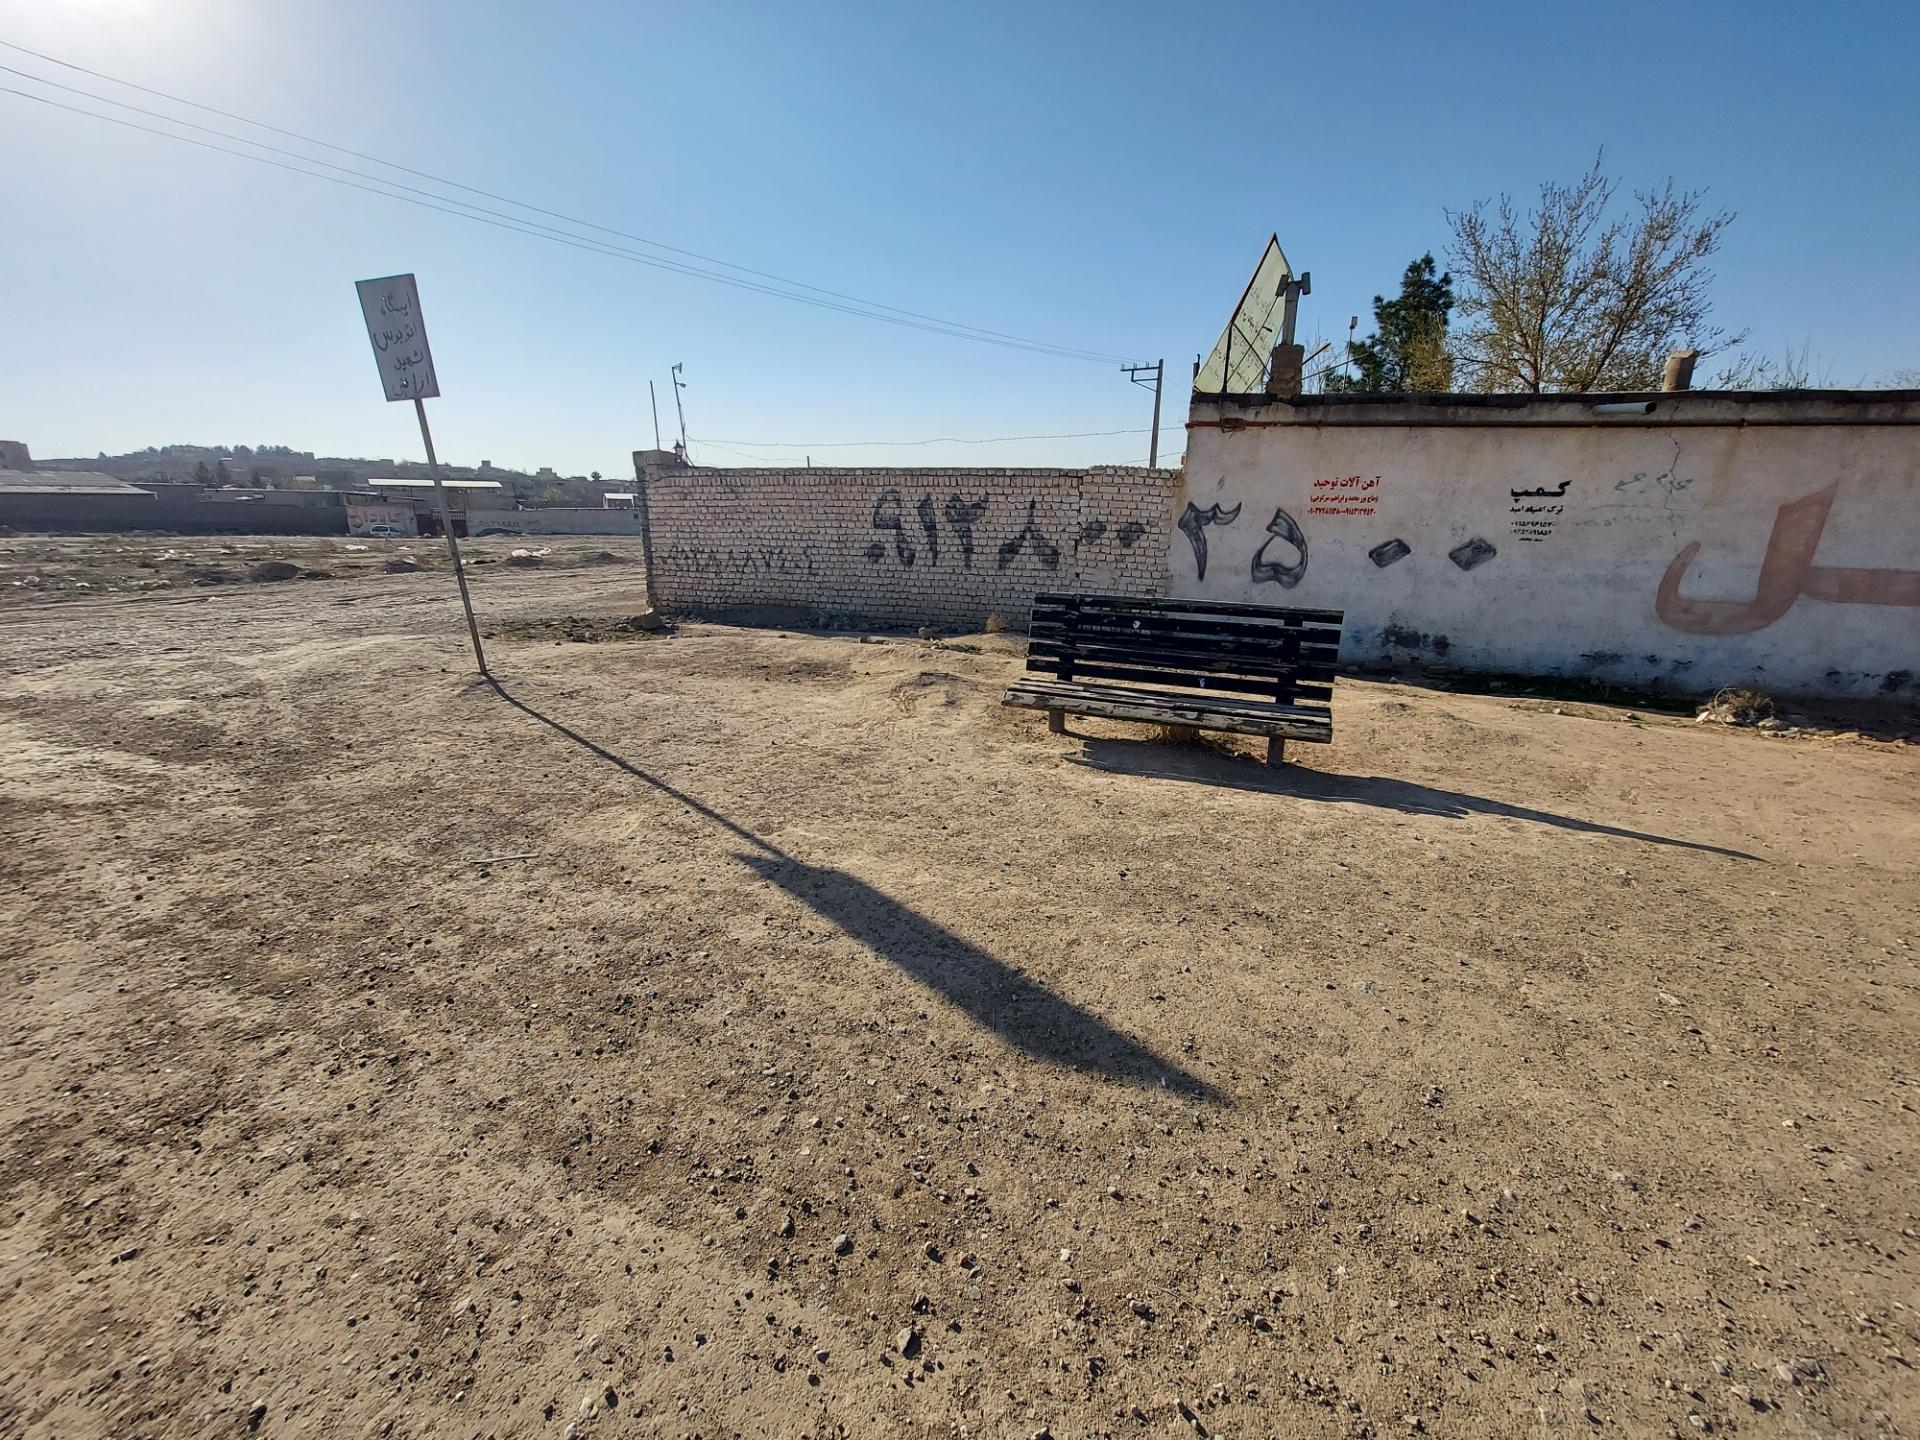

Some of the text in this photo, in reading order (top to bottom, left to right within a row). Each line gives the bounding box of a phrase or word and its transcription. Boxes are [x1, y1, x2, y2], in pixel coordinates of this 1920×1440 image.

[1313, 475, 1382, 490] آهن آلات توحید
[1510, 480, 1573, 504] کمپ
